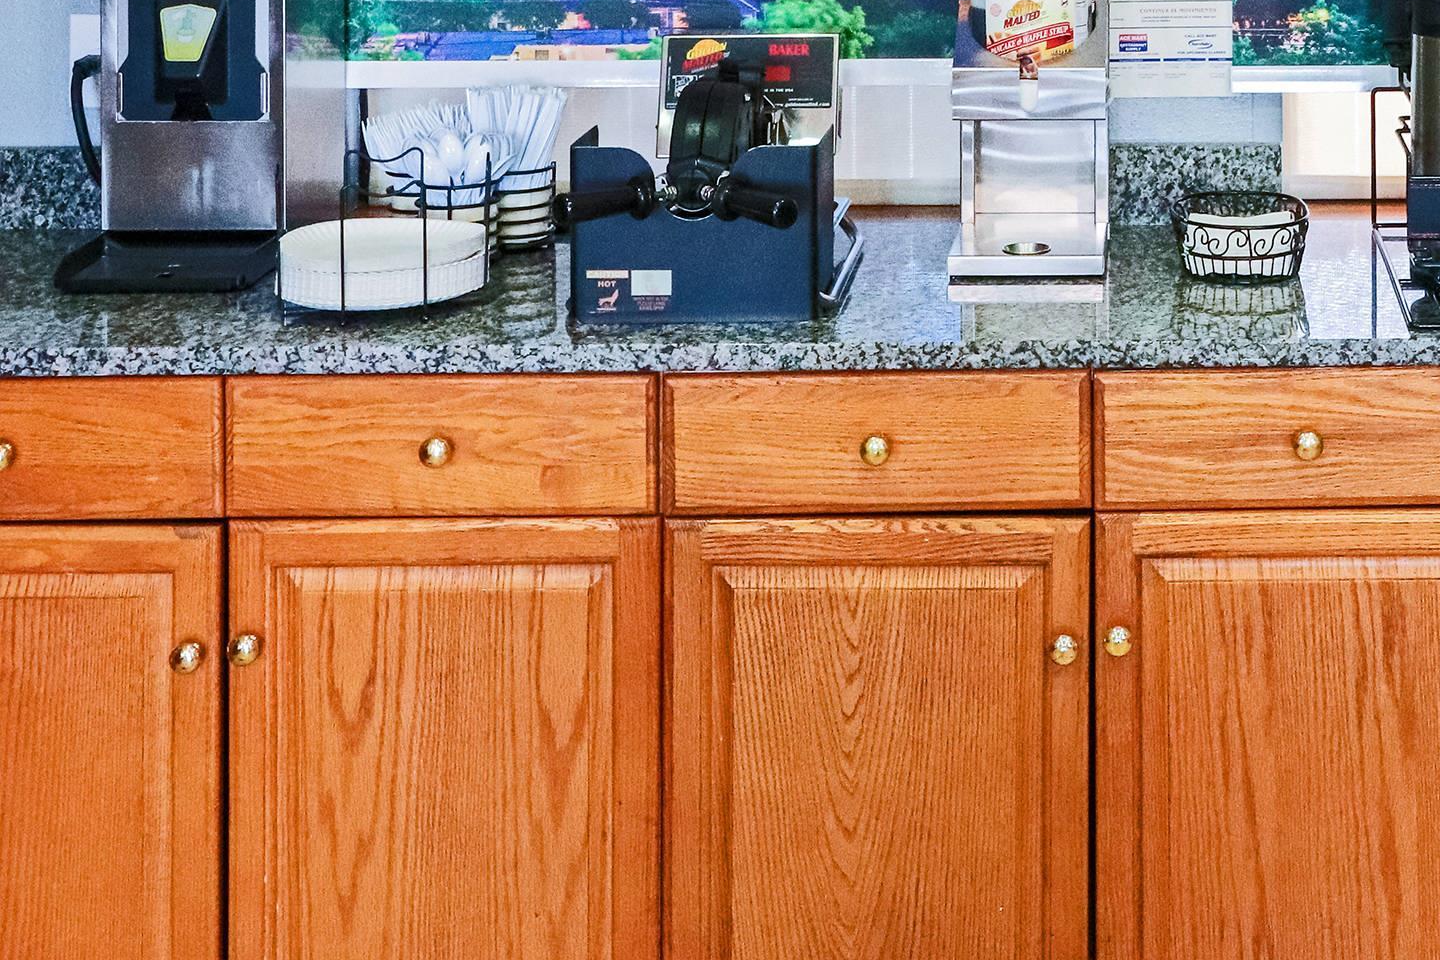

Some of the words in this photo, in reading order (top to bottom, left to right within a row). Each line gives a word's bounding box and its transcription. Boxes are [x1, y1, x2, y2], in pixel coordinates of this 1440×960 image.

[1003, 10, 1041, 29] MALTED
[767, 43, 810, 57] BAKER
[597, 280, 617, 288] HOT
